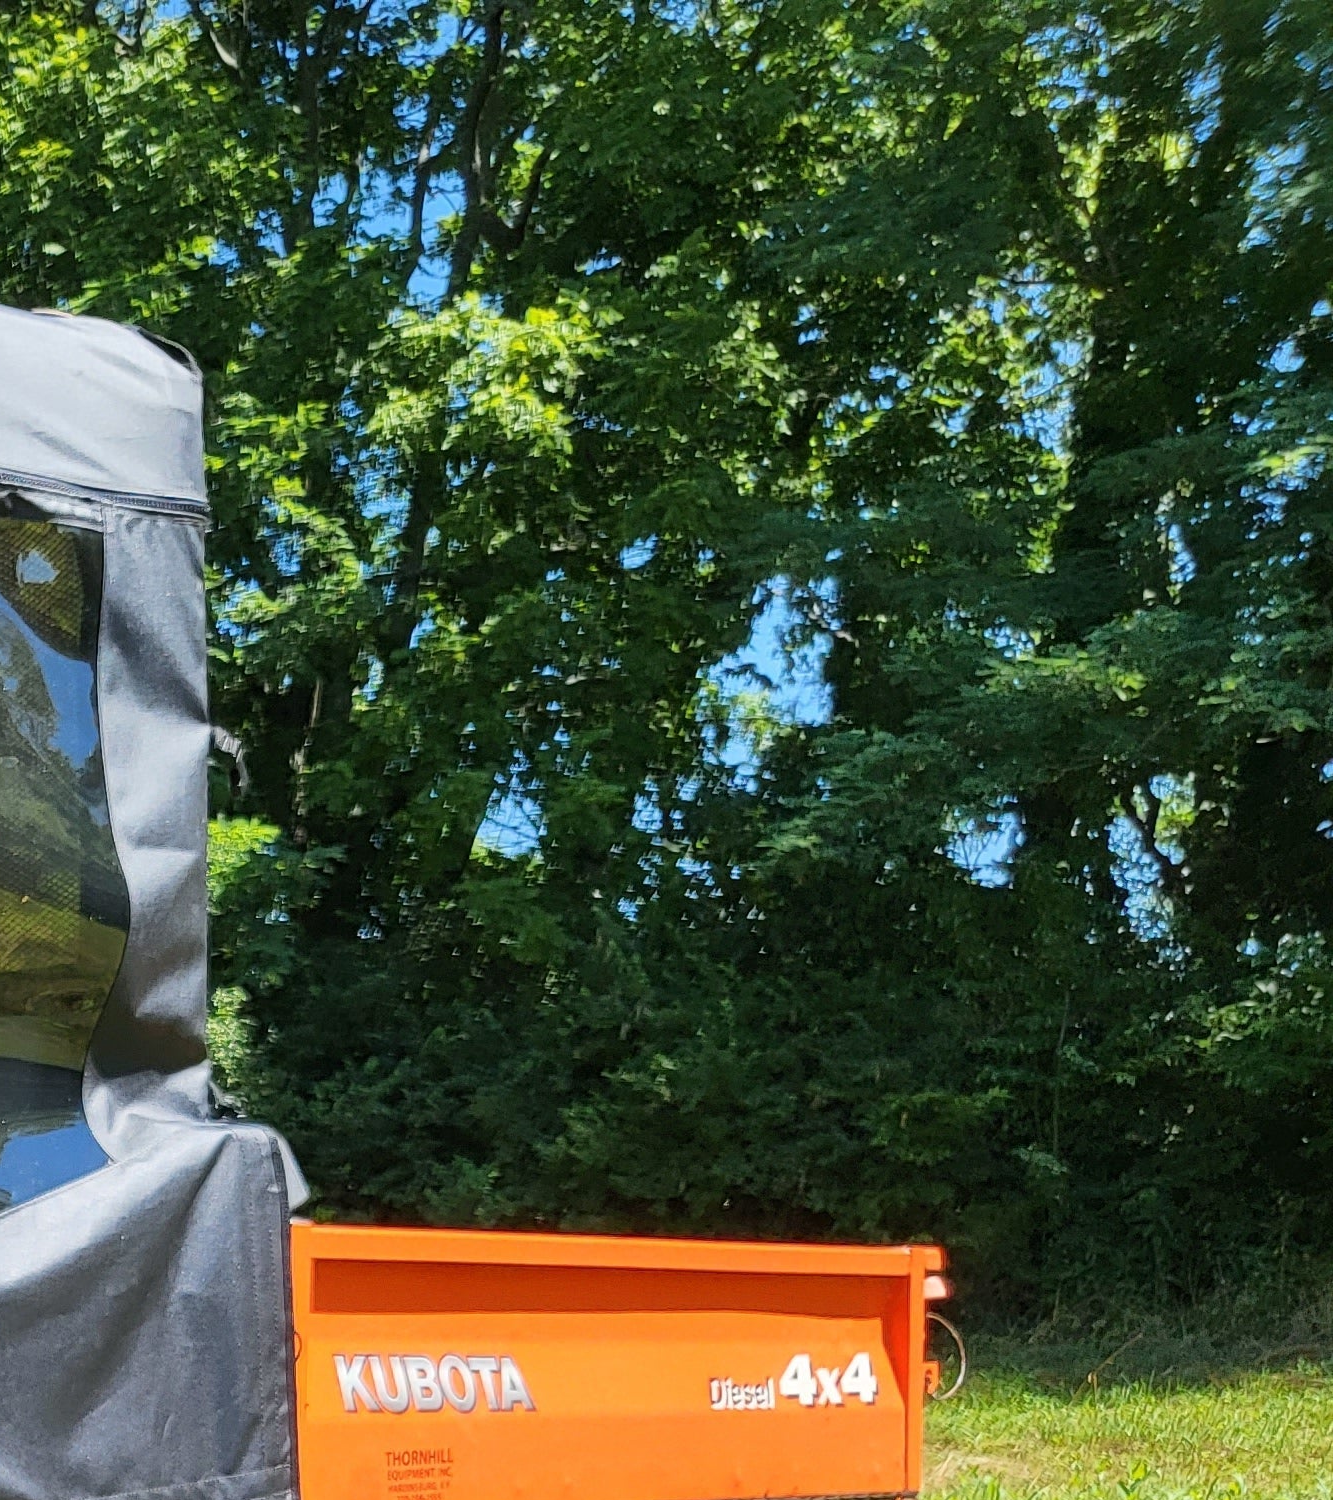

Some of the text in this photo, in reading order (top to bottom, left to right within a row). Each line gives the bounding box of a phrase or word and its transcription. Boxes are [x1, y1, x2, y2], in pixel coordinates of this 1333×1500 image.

[333, 1354, 536, 1414] KUBOTA
[709, 1352, 878, 1411] Diesel 4x4
[384, 1447, 454, 1467] THORNHILL
